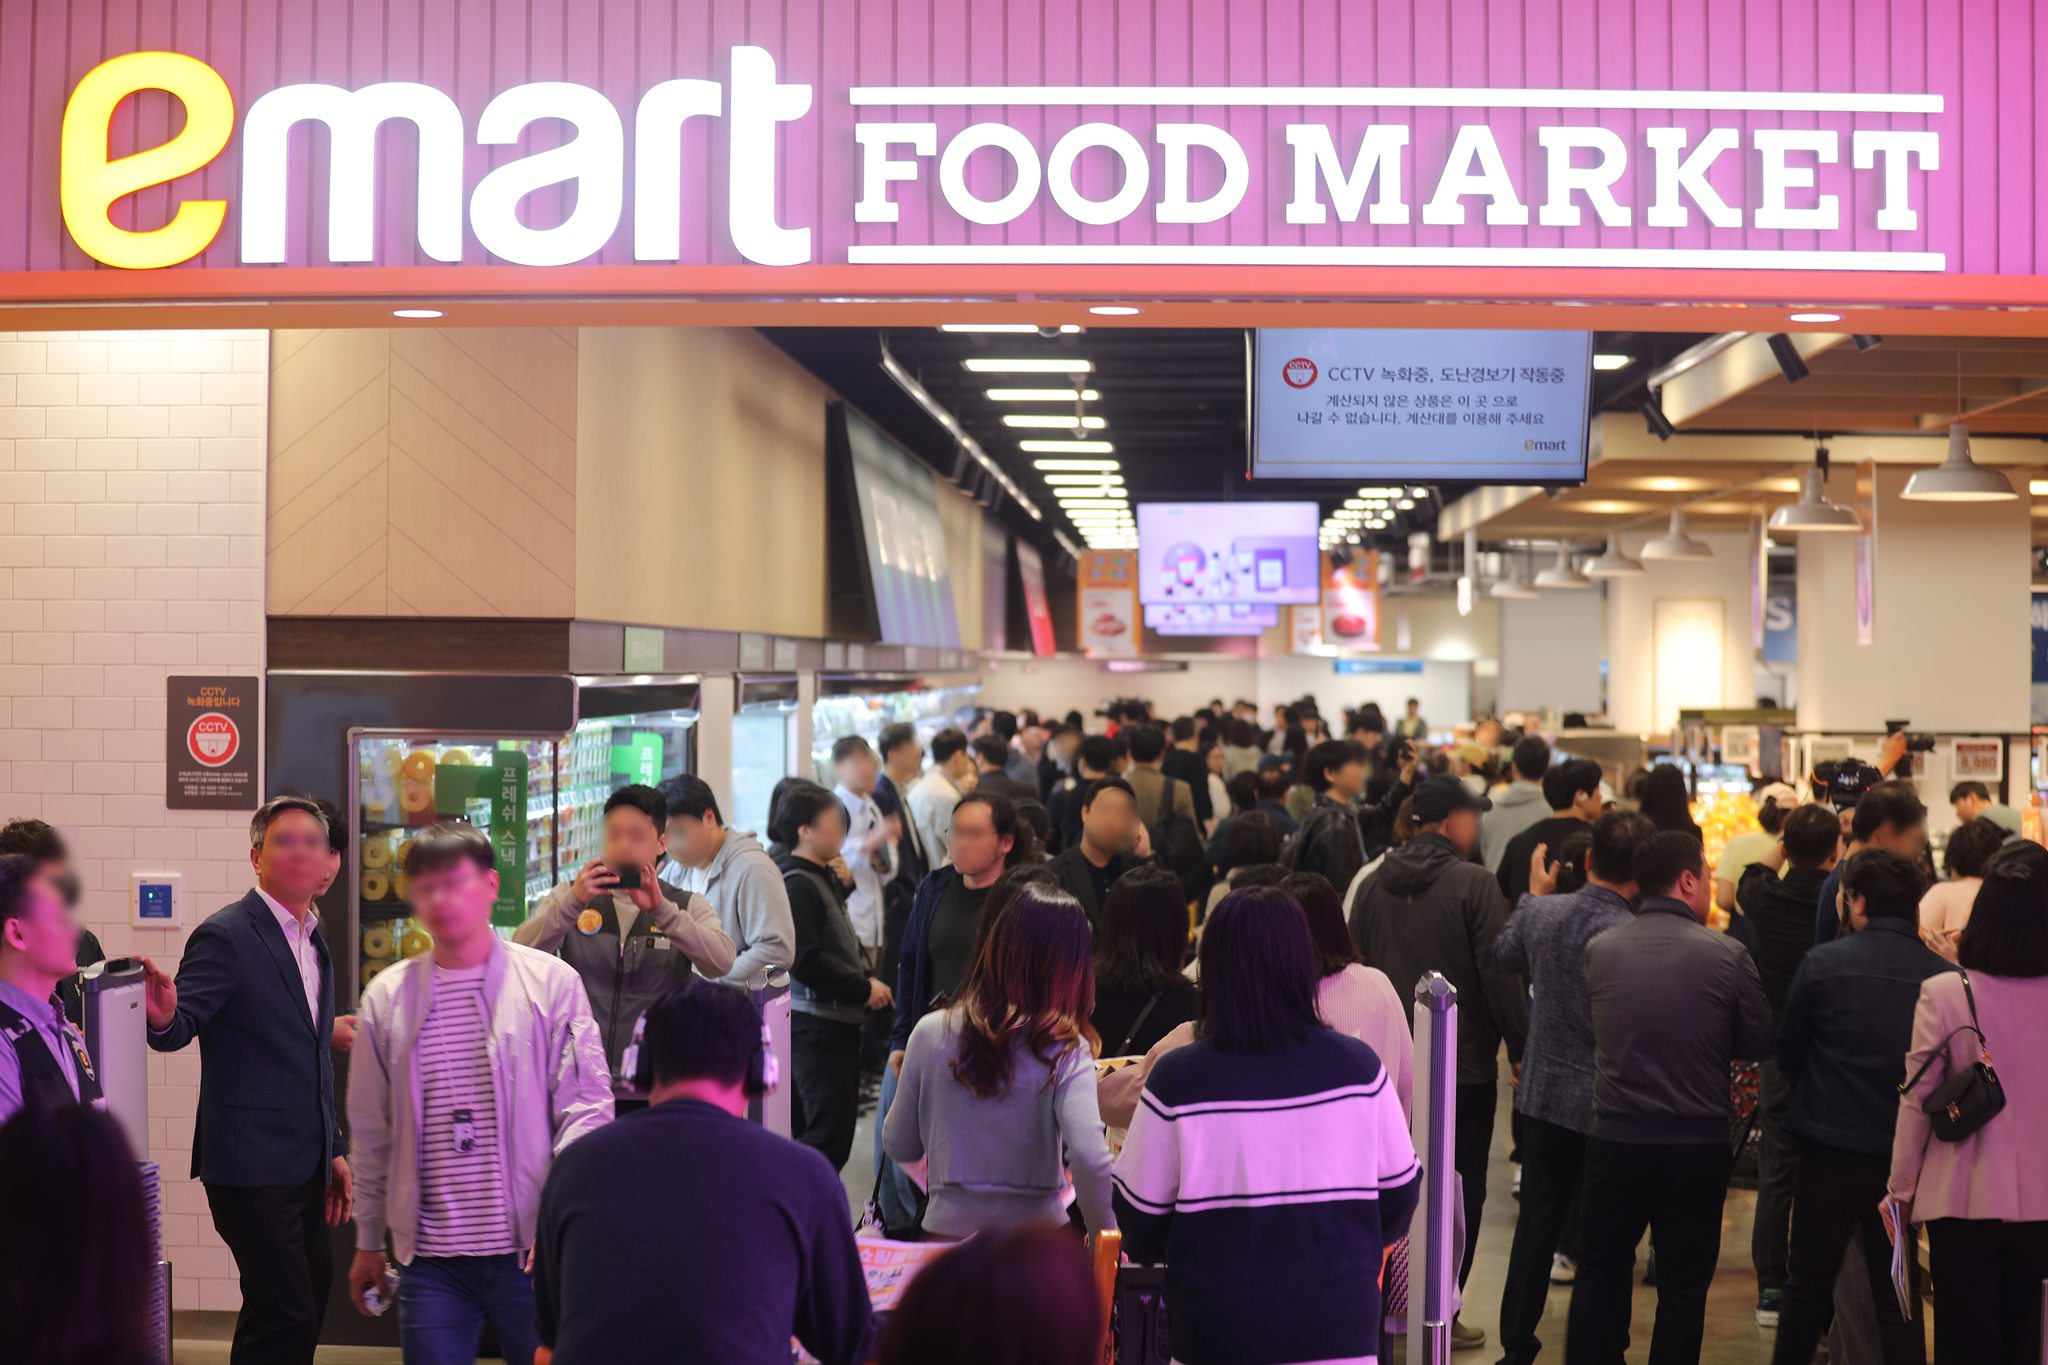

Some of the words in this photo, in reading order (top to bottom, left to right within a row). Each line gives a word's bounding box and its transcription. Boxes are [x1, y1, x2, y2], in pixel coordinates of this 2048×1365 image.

[61, 45, 813, 270] emart
[854, 122, 1249, 225] FOOD
[1285, 123, 1940, 231] MARKET
[1289, 361, 1312, 370] CCTV
[1328, 367, 1375, 381] CCTV
[1381, 366, 1434, 384] 녹화중,
[1440, 367, 1516, 383] 도난경보기
[1520, 367, 1566, 384] 작동중
[1326, 394, 1379, 408] 계산되지
[1383, 394, 1409, 408] 않은
[1414, 394, 1453, 408] 상품은
[1458, 394, 1470, 408] 이
[1475, 395, 1488, 408] 곳
[1492, 395, 1519, 407] 으로
[1297, 411, 1323, 425] 나갈
[1328, 412, 1341, 425] 수
[1345, 411, 1401, 426] 없습니다.
[1406, 412, 1458, 425] 계산대를
[1463, 412, 1502, 426] 이용해
[1506, 412, 1545, 426] 주세요
[1524, 439, 1567, 452] emart
[200, 687, 227, 696] CCTV
[187, 696, 240, 707] 녹화중입니다
[198, 722, 228, 732] CCTV
[501, 766, 518, 823] 프레쉬
[500, 830, 517, 867] 스낵
